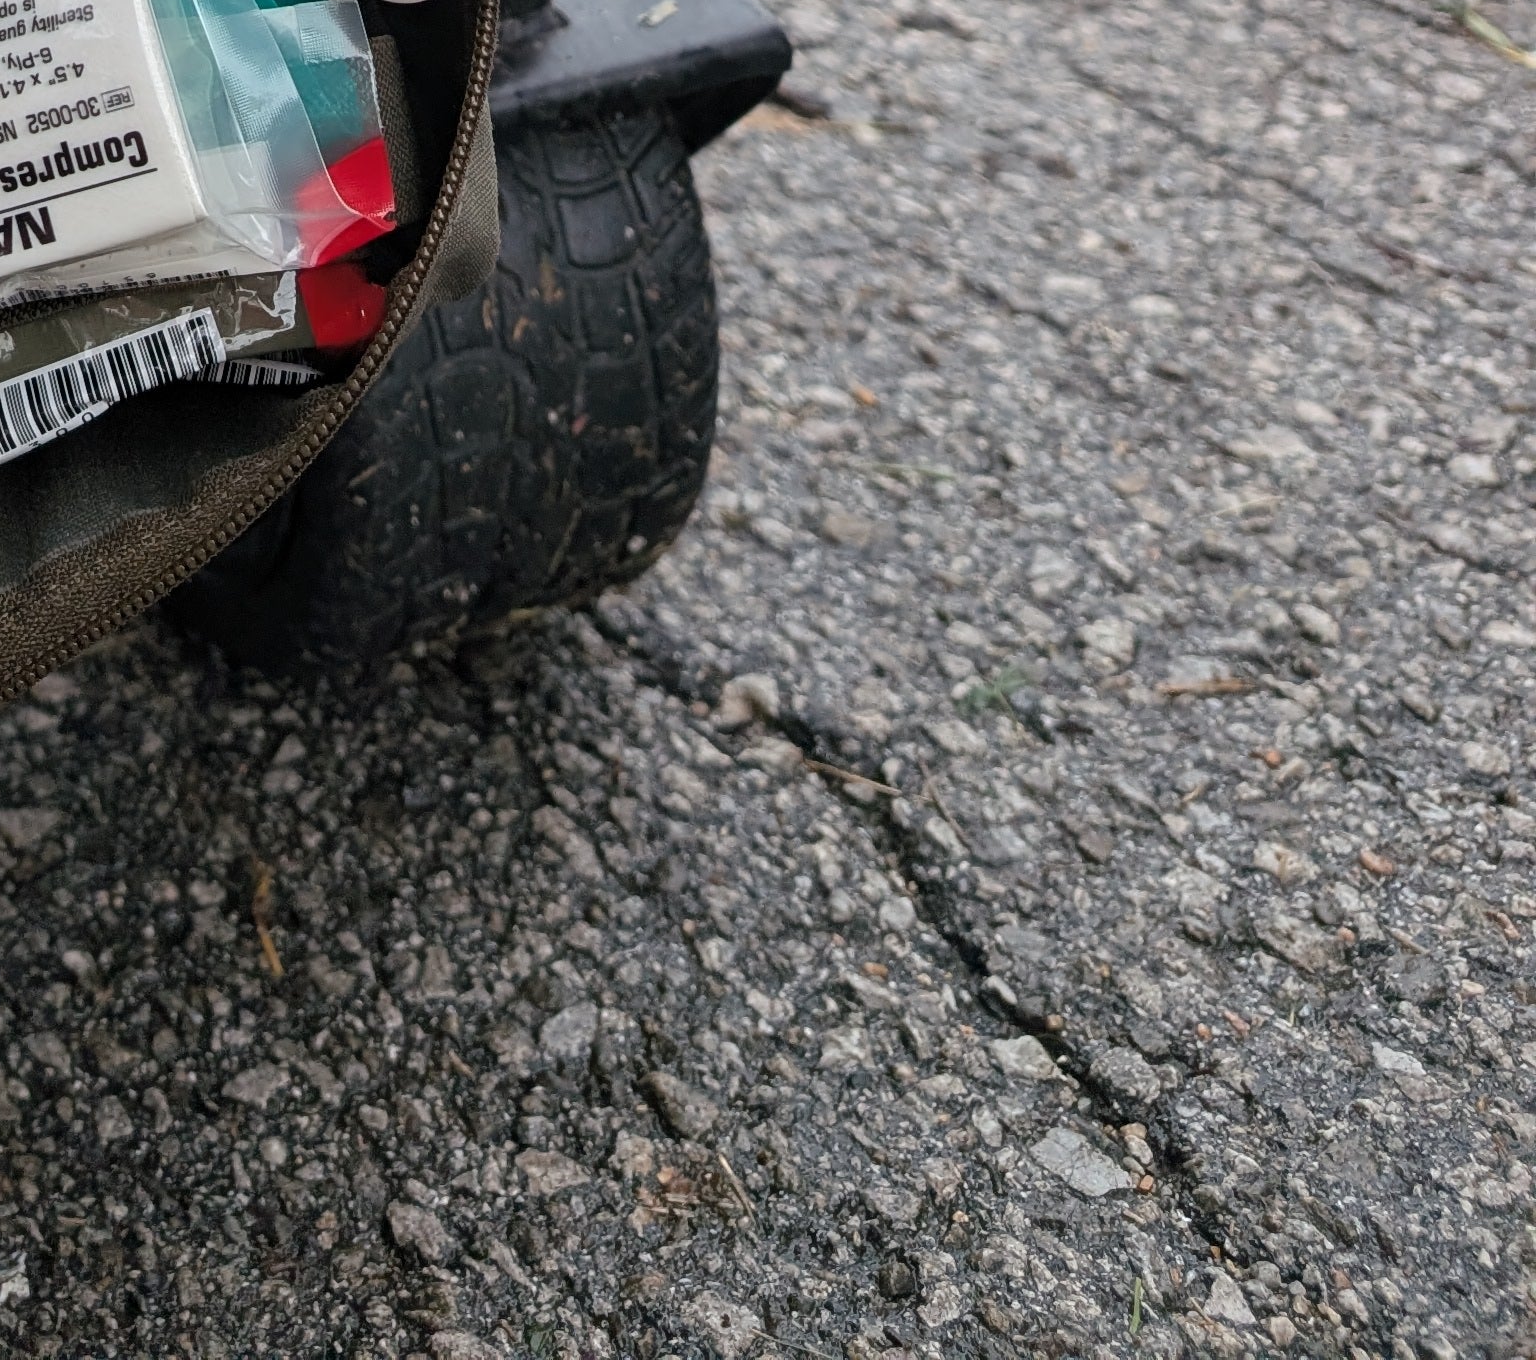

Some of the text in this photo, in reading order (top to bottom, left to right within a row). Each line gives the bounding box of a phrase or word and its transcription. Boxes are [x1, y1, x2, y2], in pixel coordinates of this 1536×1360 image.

[31, 4, 95, 33] Sterility
[1, 47, 53, 75] 6-Ply,
[0, 77, 26, 98] 4.1
[31, 73, 42, 86] x
[107, 89, 132, 109] REF
[26, 96, 101, 134] 30-0052
